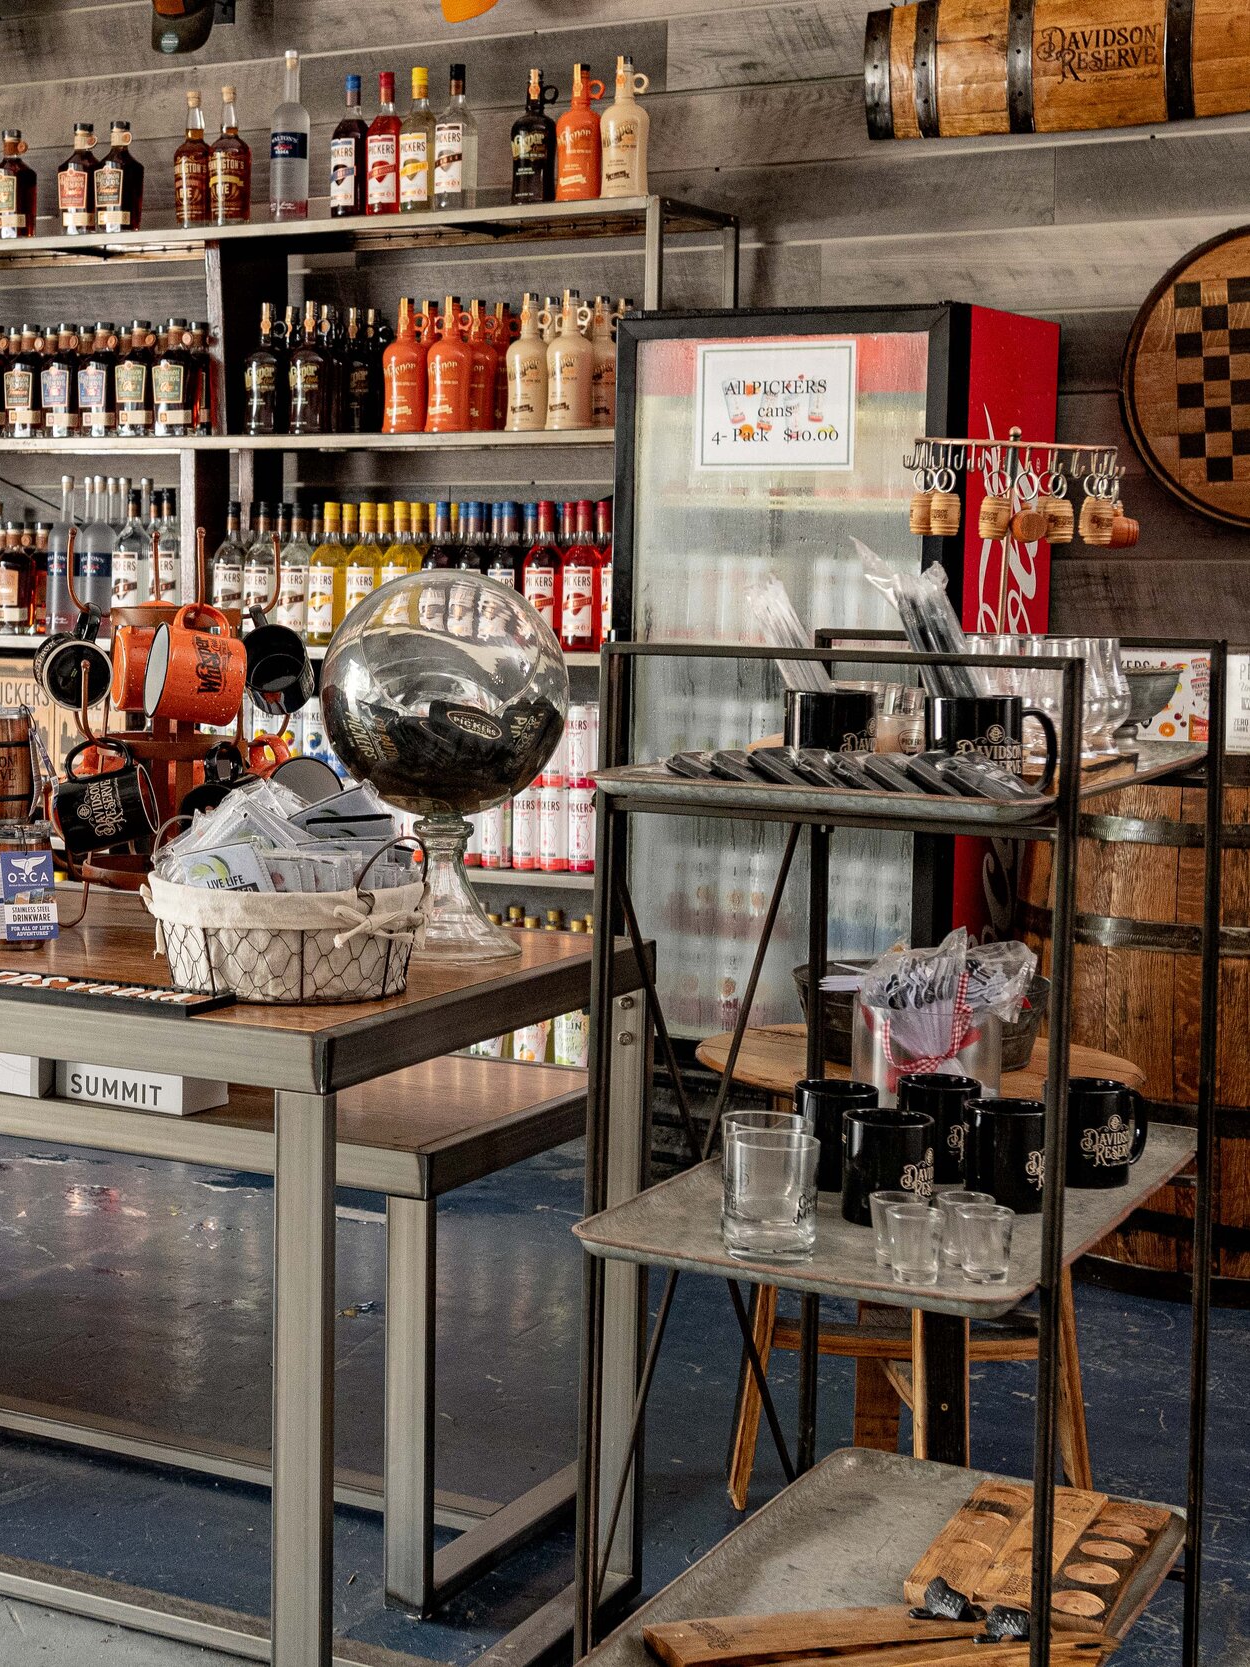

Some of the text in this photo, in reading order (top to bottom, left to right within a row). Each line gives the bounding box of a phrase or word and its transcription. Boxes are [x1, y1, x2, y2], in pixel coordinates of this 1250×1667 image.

[1036, 23, 1162, 62] DAVIDSON
[1055, 45, 1158, 85] RESERVE
[725, 378, 827, 396] All PICKERS
[757, 405, 793, 418] cans
[733, 428, 769, 442] Pack
[783, 428, 839, 443] $10.00
[215, 572, 241, 584] PCKERS
[244, 575, 267, 586] PICERS
[280, 573, 304, 585] ICKERS
[309, 575, 333, 586] PICERS
[347, 575, 373, 587] PIKERS
[525, 576, 553, 588] PIKERS
[564, 576, 591, 588] PIKERS
[100, 779, 127, 827] RESERVE
[515, 800, 536, 810] CKERS
[542, 800, 560, 810] CKERS
[569, 803, 594, 812] ICKERS
[88, 782, 116, 837] DAVIDSON
[8, 872, 49, 883] ORCA
[206, 874, 245, 889] LIVE LIFE
[12, 906, 50, 914] STAINLESS STEEL
[13, 913, 51, 922] DRINKWARE
[70, 1073, 162, 1106] SUMMIT
